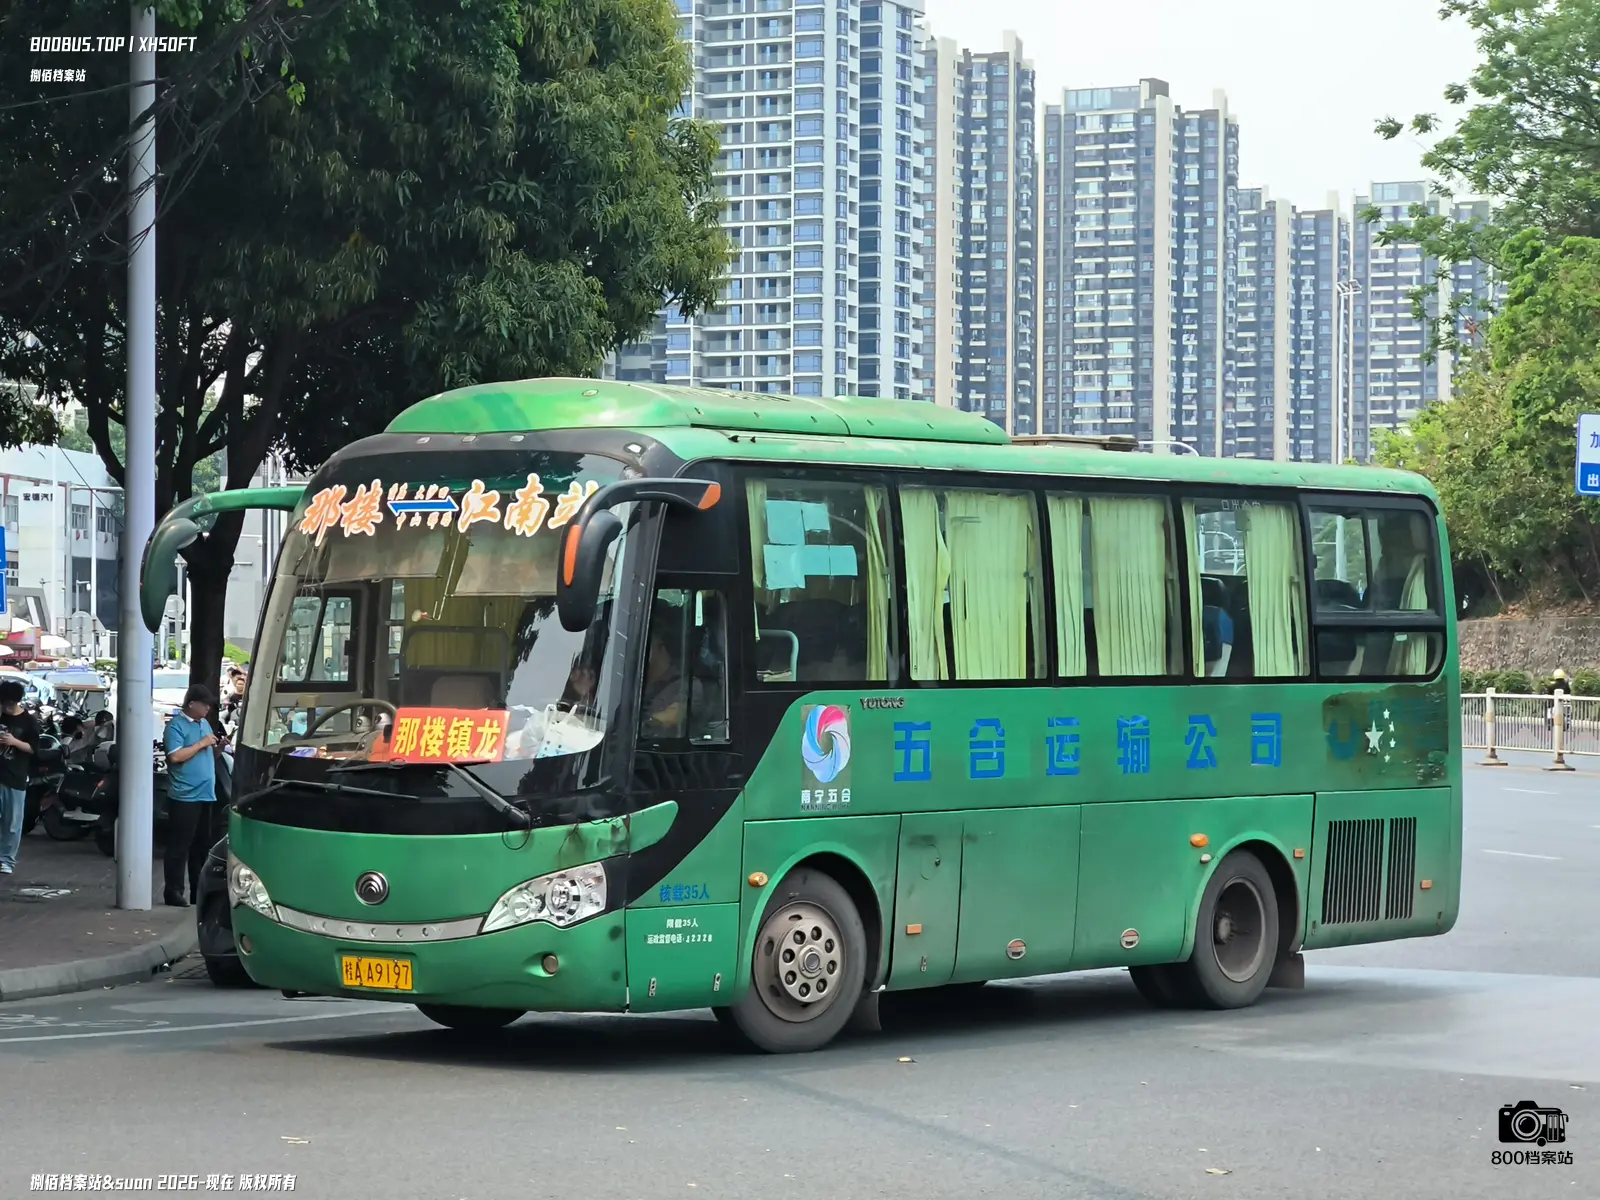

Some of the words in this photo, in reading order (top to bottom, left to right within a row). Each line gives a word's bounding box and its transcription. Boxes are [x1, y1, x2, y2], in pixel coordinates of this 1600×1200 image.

[300, 478, 383, 547] 那楼
[860, 697, 905, 710] YUTONG
[393, 716, 501, 759] 那楼镇龙
[893, 712, 1282, 782] 五合运输公司
[801, 788, 851, 804] 南宁五合
